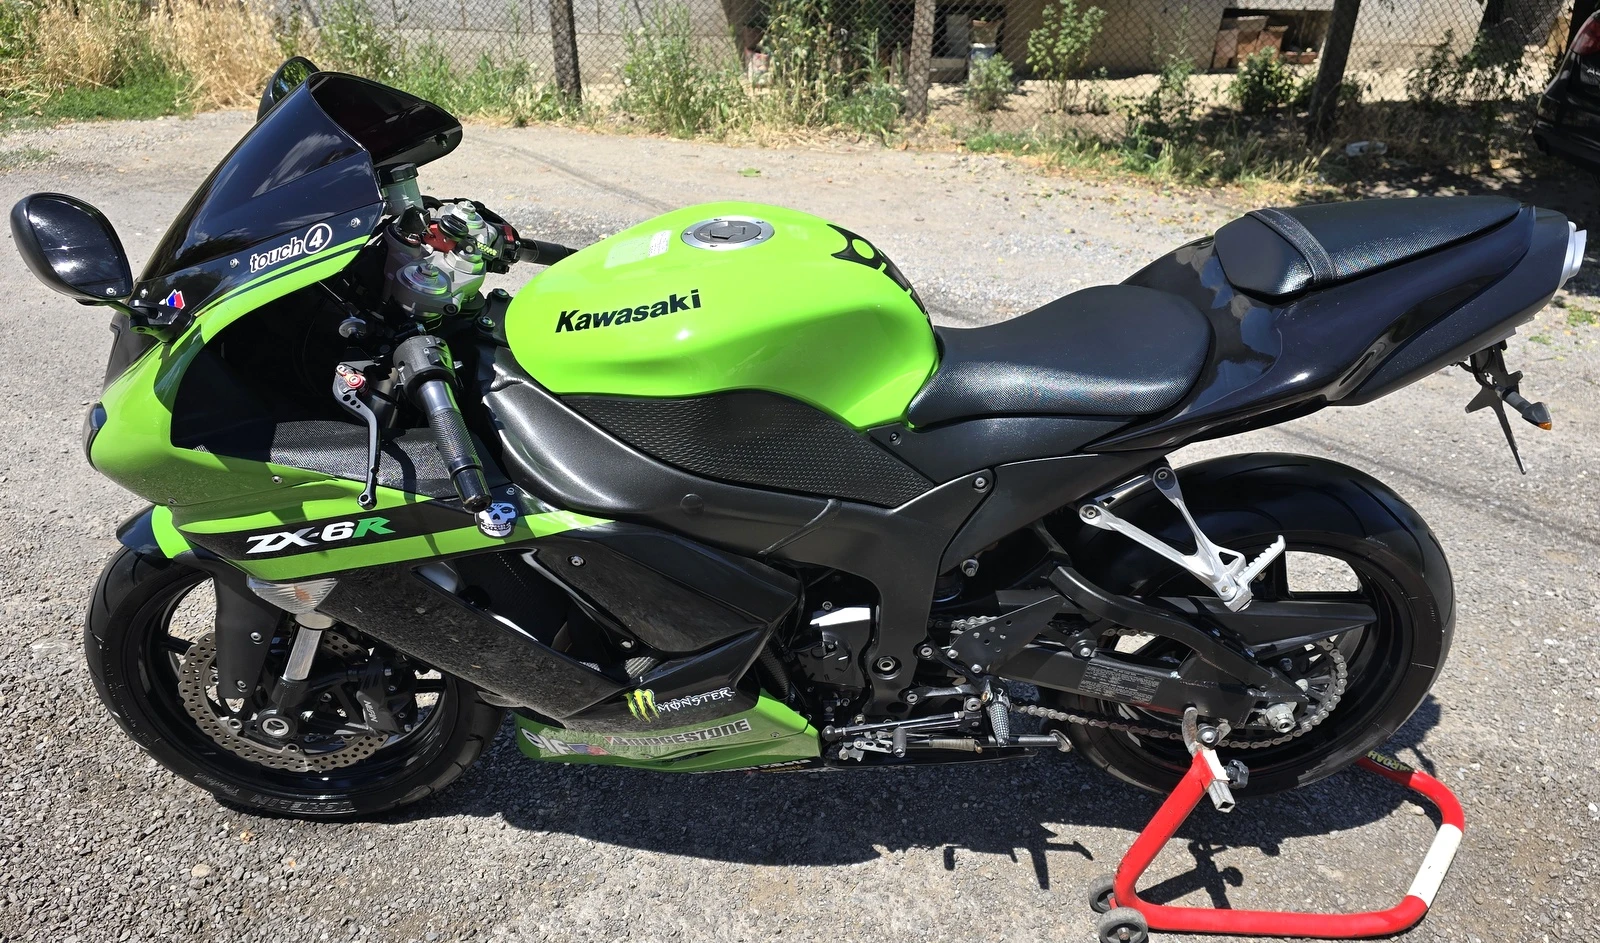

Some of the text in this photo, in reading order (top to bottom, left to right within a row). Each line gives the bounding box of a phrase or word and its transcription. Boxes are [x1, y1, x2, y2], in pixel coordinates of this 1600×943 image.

[250, 237, 304, 273] touch
[555, 289, 701, 333] Kawasaki
[246, 517, 395, 554] ZX-6R
[656, 687, 735, 712] MONSTER
[603, 719, 751, 746] BRIDGESTONE
